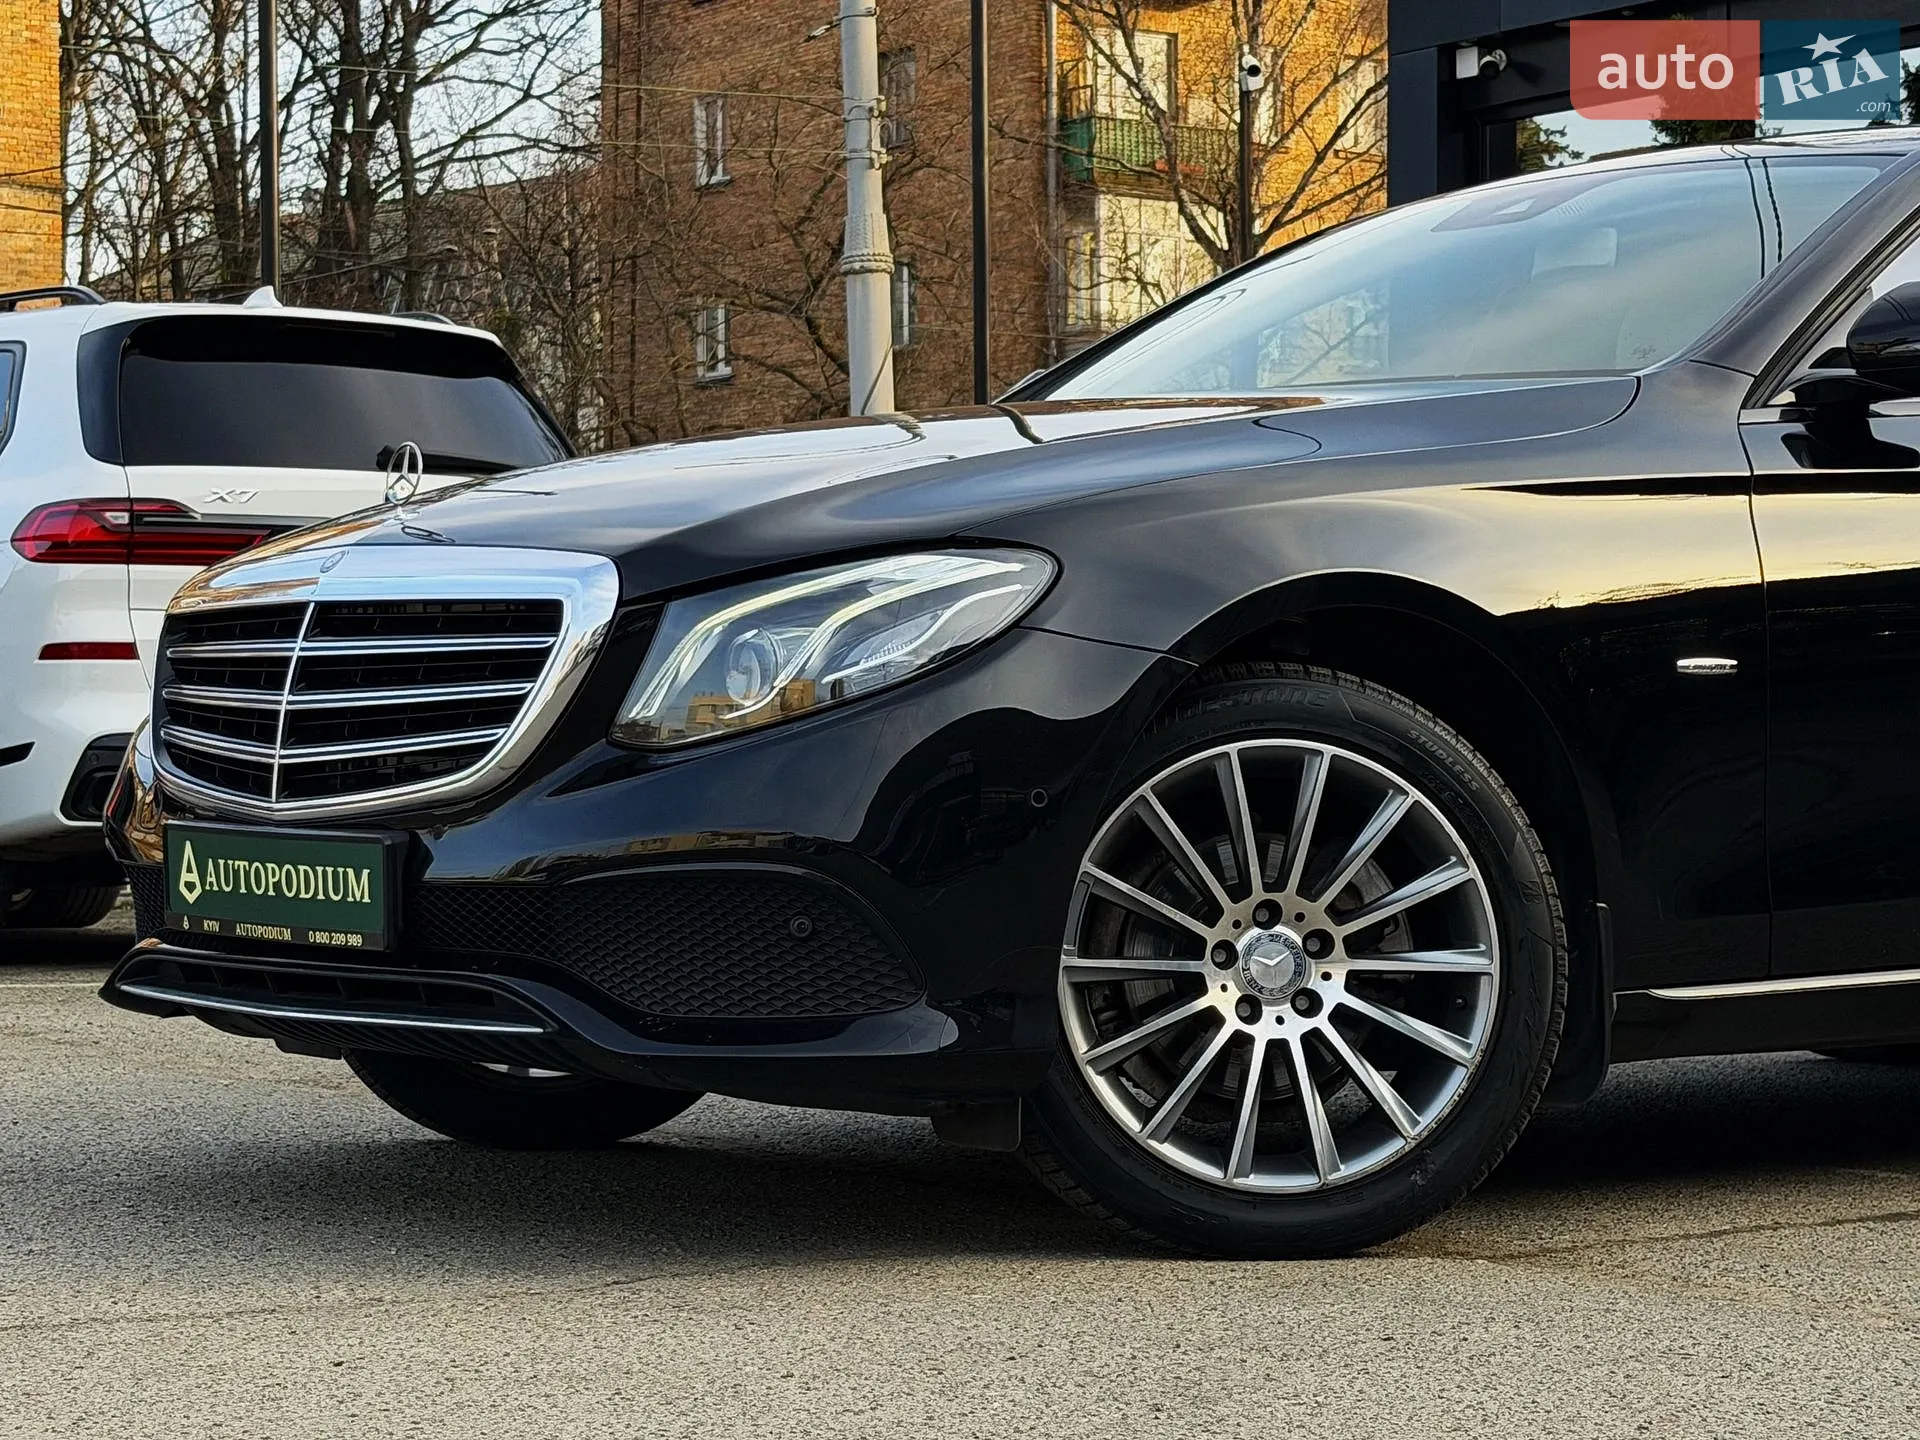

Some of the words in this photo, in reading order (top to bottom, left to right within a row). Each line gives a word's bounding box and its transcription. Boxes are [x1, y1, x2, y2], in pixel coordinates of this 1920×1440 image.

[203, 487, 260, 504] X7
[1407, 730, 1479, 791] STUDLESS
[204, 858, 371, 903] AUTOPODIUM
[203, 919, 220, 932] KYIV
[235, 923, 292, 941] AUTOPODIUM
[315, 932, 330, 944] 800
[331, 932, 346, 945] 209
[347, 934, 363, 947] 989
